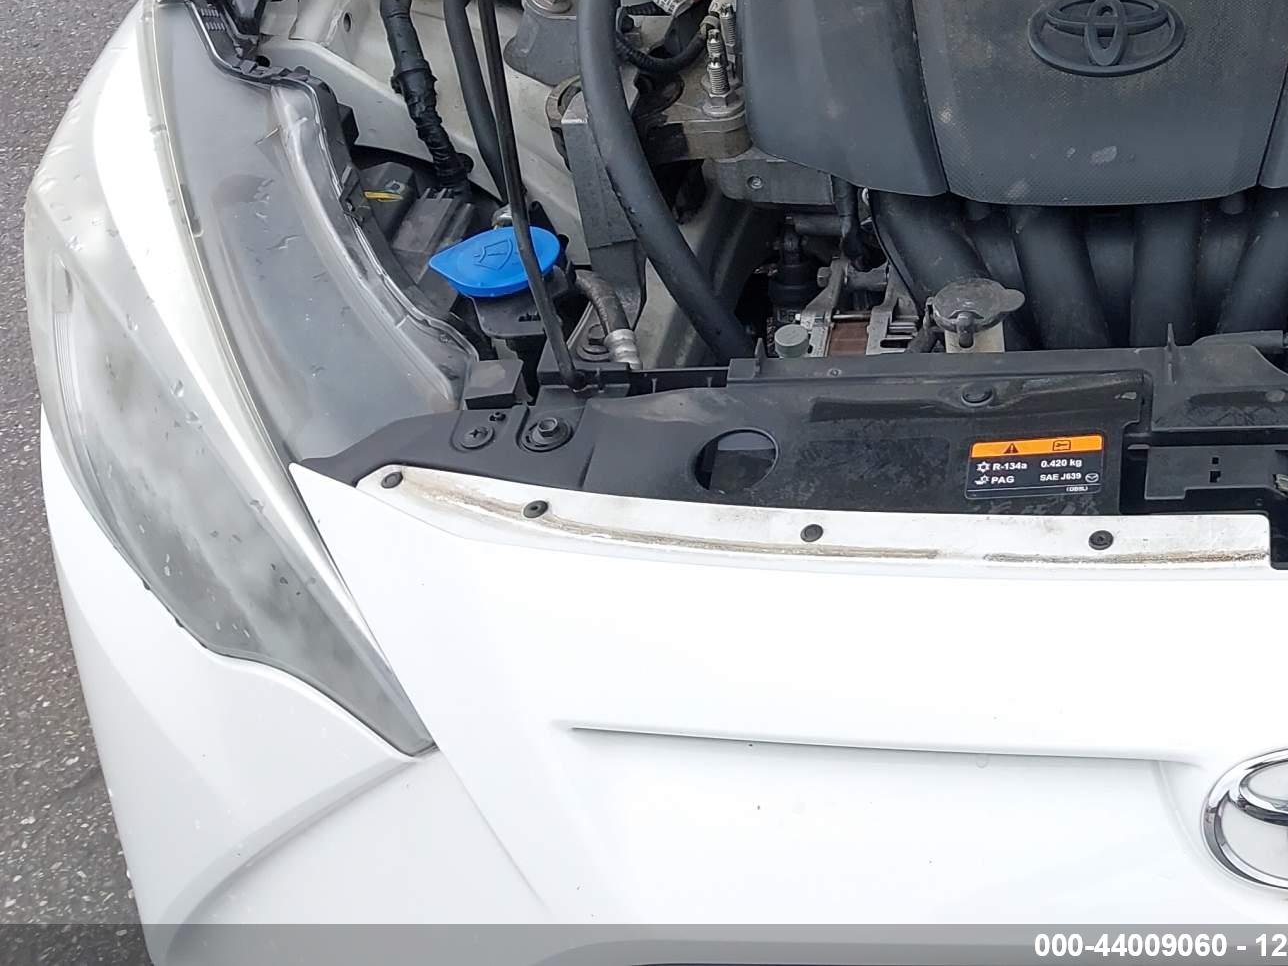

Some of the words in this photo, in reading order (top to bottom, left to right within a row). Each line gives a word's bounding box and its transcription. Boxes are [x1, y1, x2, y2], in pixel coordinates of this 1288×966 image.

[992, 462, 1028, 471] R-134a
[1041, 459, 1068, 468] 0.420
[1069, 459, 1083, 469] kg
[991, 475, 1015, 484] PAG
[1040, 474, 1060, 482] SAE
[1061, 472, 1082, 481] J639
